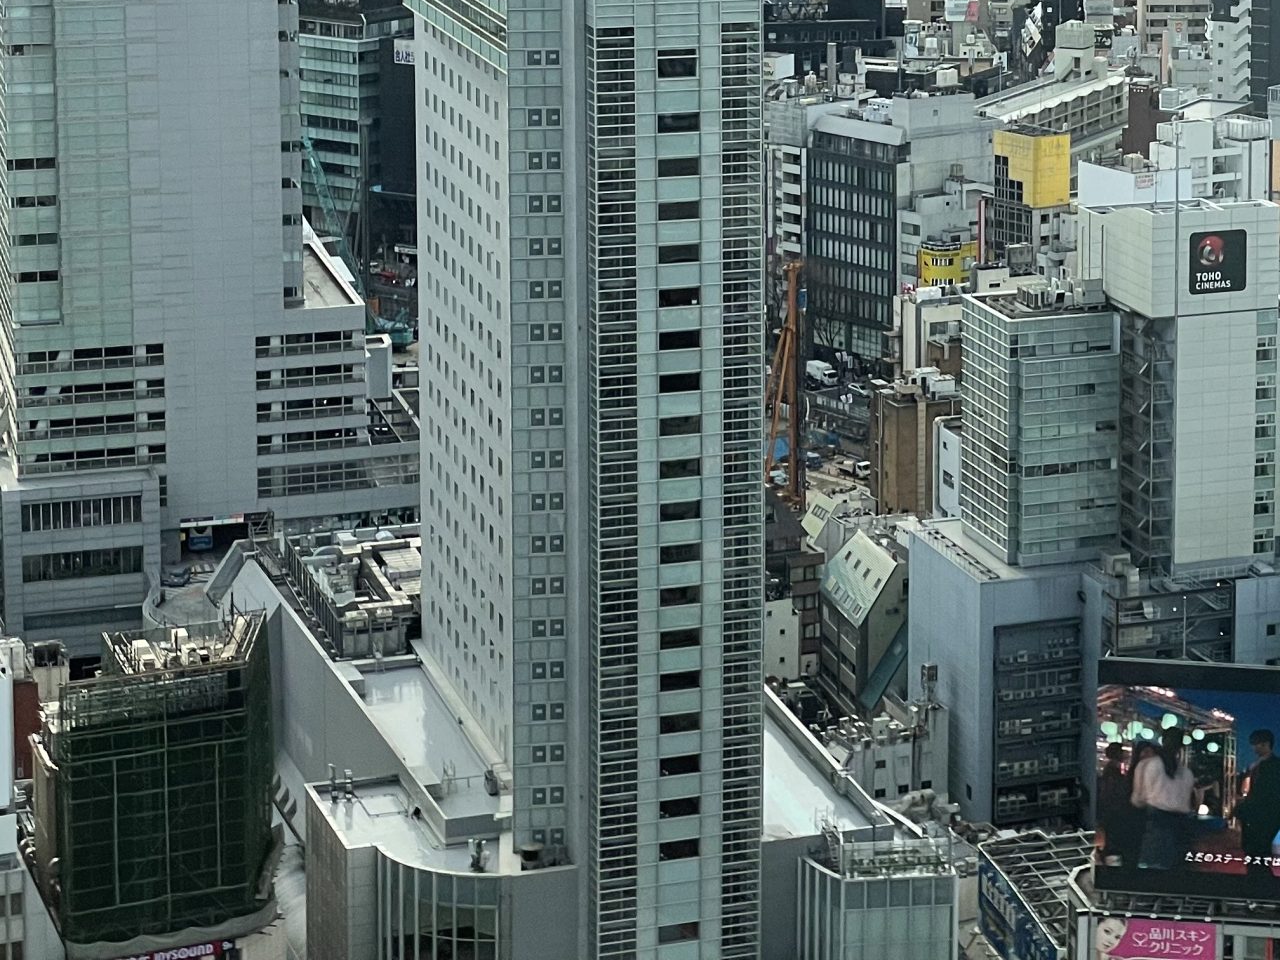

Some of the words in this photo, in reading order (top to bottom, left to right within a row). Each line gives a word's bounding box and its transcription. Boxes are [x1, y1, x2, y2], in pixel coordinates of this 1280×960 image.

[1195, 272, 1222, 282] TOHO
[1195, 280, 1231, 290] CINEMAS
[1149, 927, 1211, 942] 品川スキン
[1149, 941, 1204, 956] クリニック
